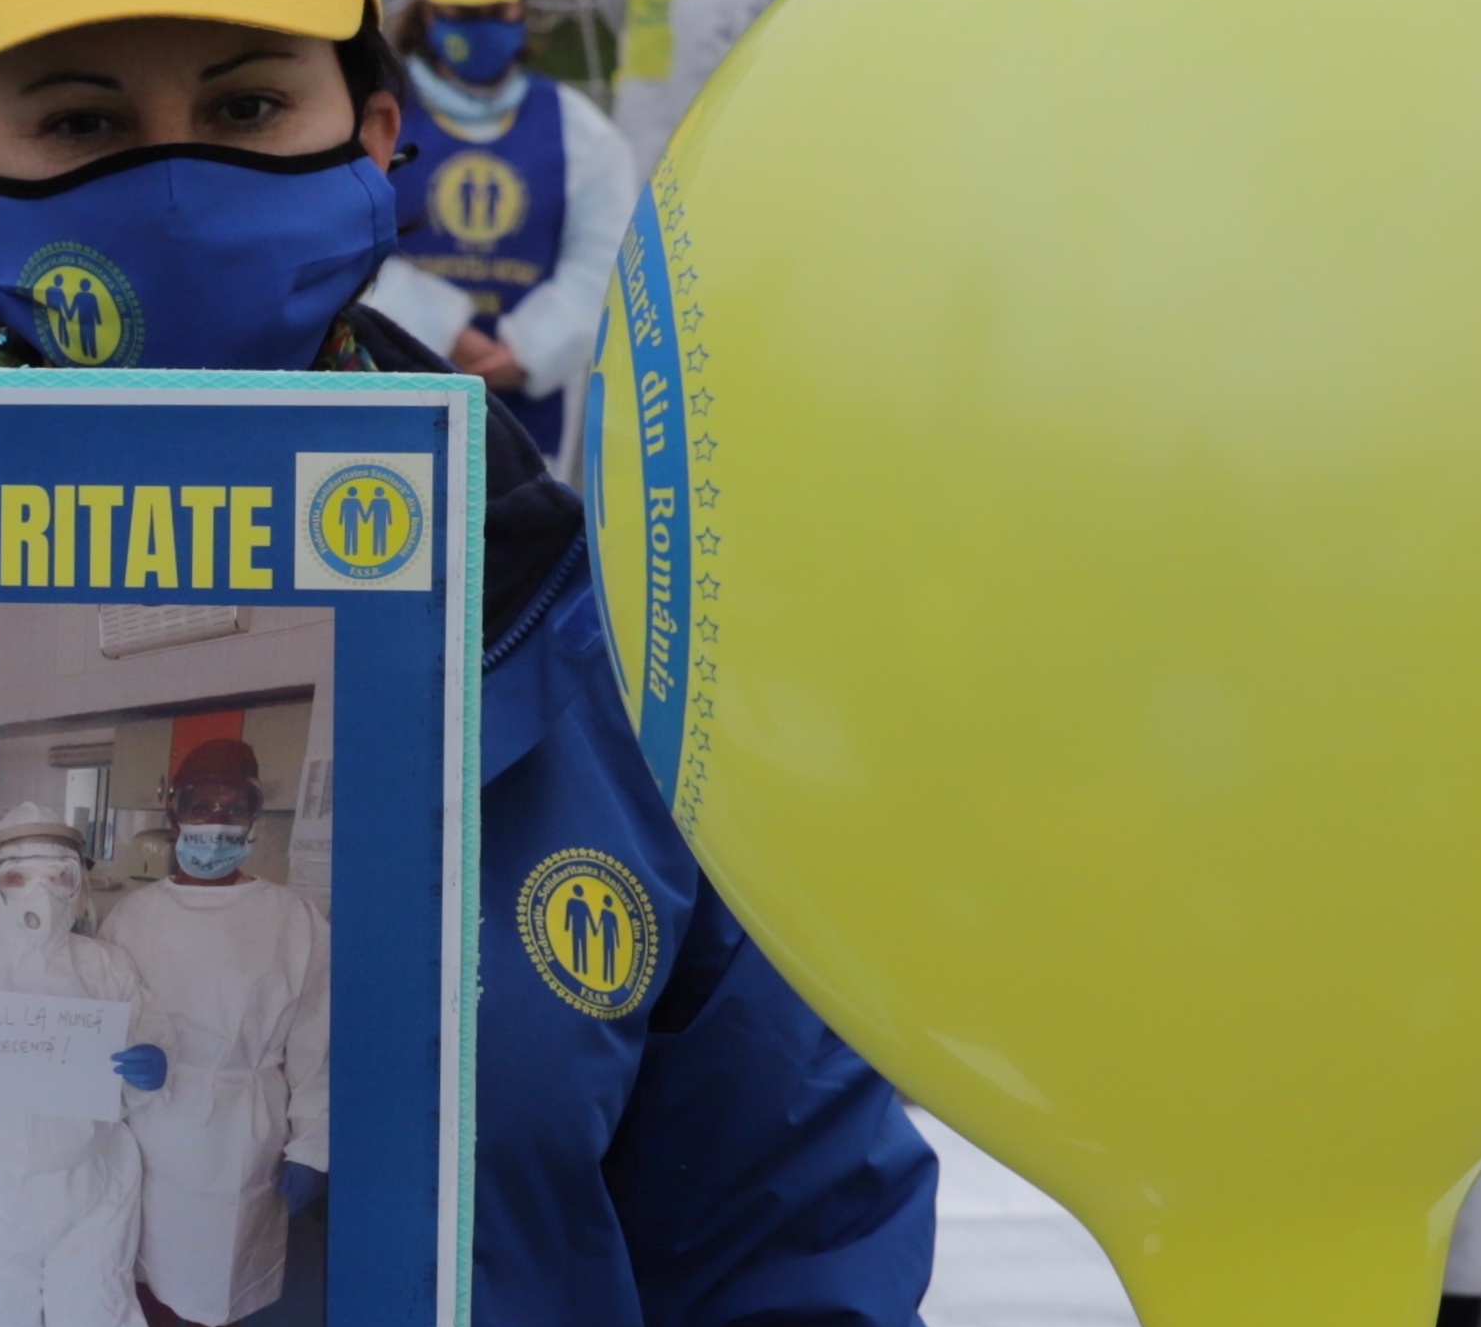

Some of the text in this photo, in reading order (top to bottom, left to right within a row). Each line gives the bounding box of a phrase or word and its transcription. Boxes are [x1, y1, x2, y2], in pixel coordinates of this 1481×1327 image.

[641, 370, 668, 457] din
[648, 486, 678, 703] România
[23, 1007, 47, 1032] LA
[58, 1007, 106, 1035] MUNCĂ
